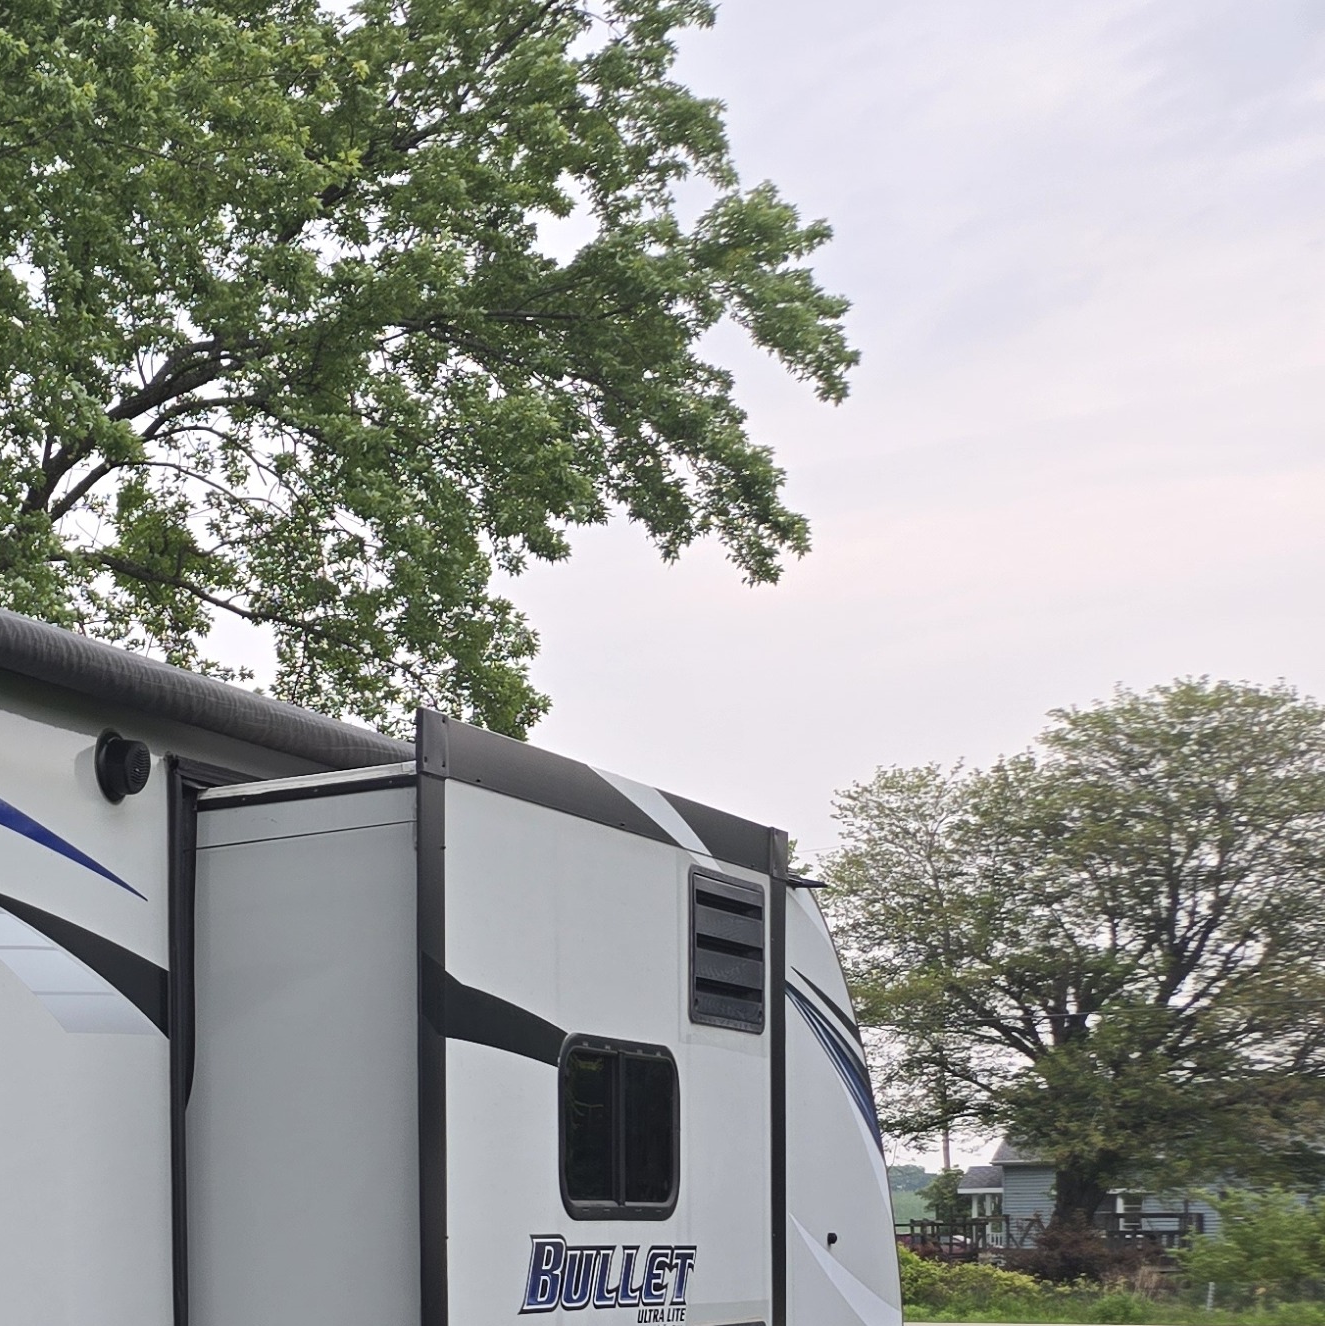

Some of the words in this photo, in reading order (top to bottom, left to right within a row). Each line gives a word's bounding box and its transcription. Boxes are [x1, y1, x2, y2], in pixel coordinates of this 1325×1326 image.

[517, 1234, 697, 1315] BULLET
[637, 1309, 664, 1323] ULTRA
[667, 1308, 686, 1322] LITE
